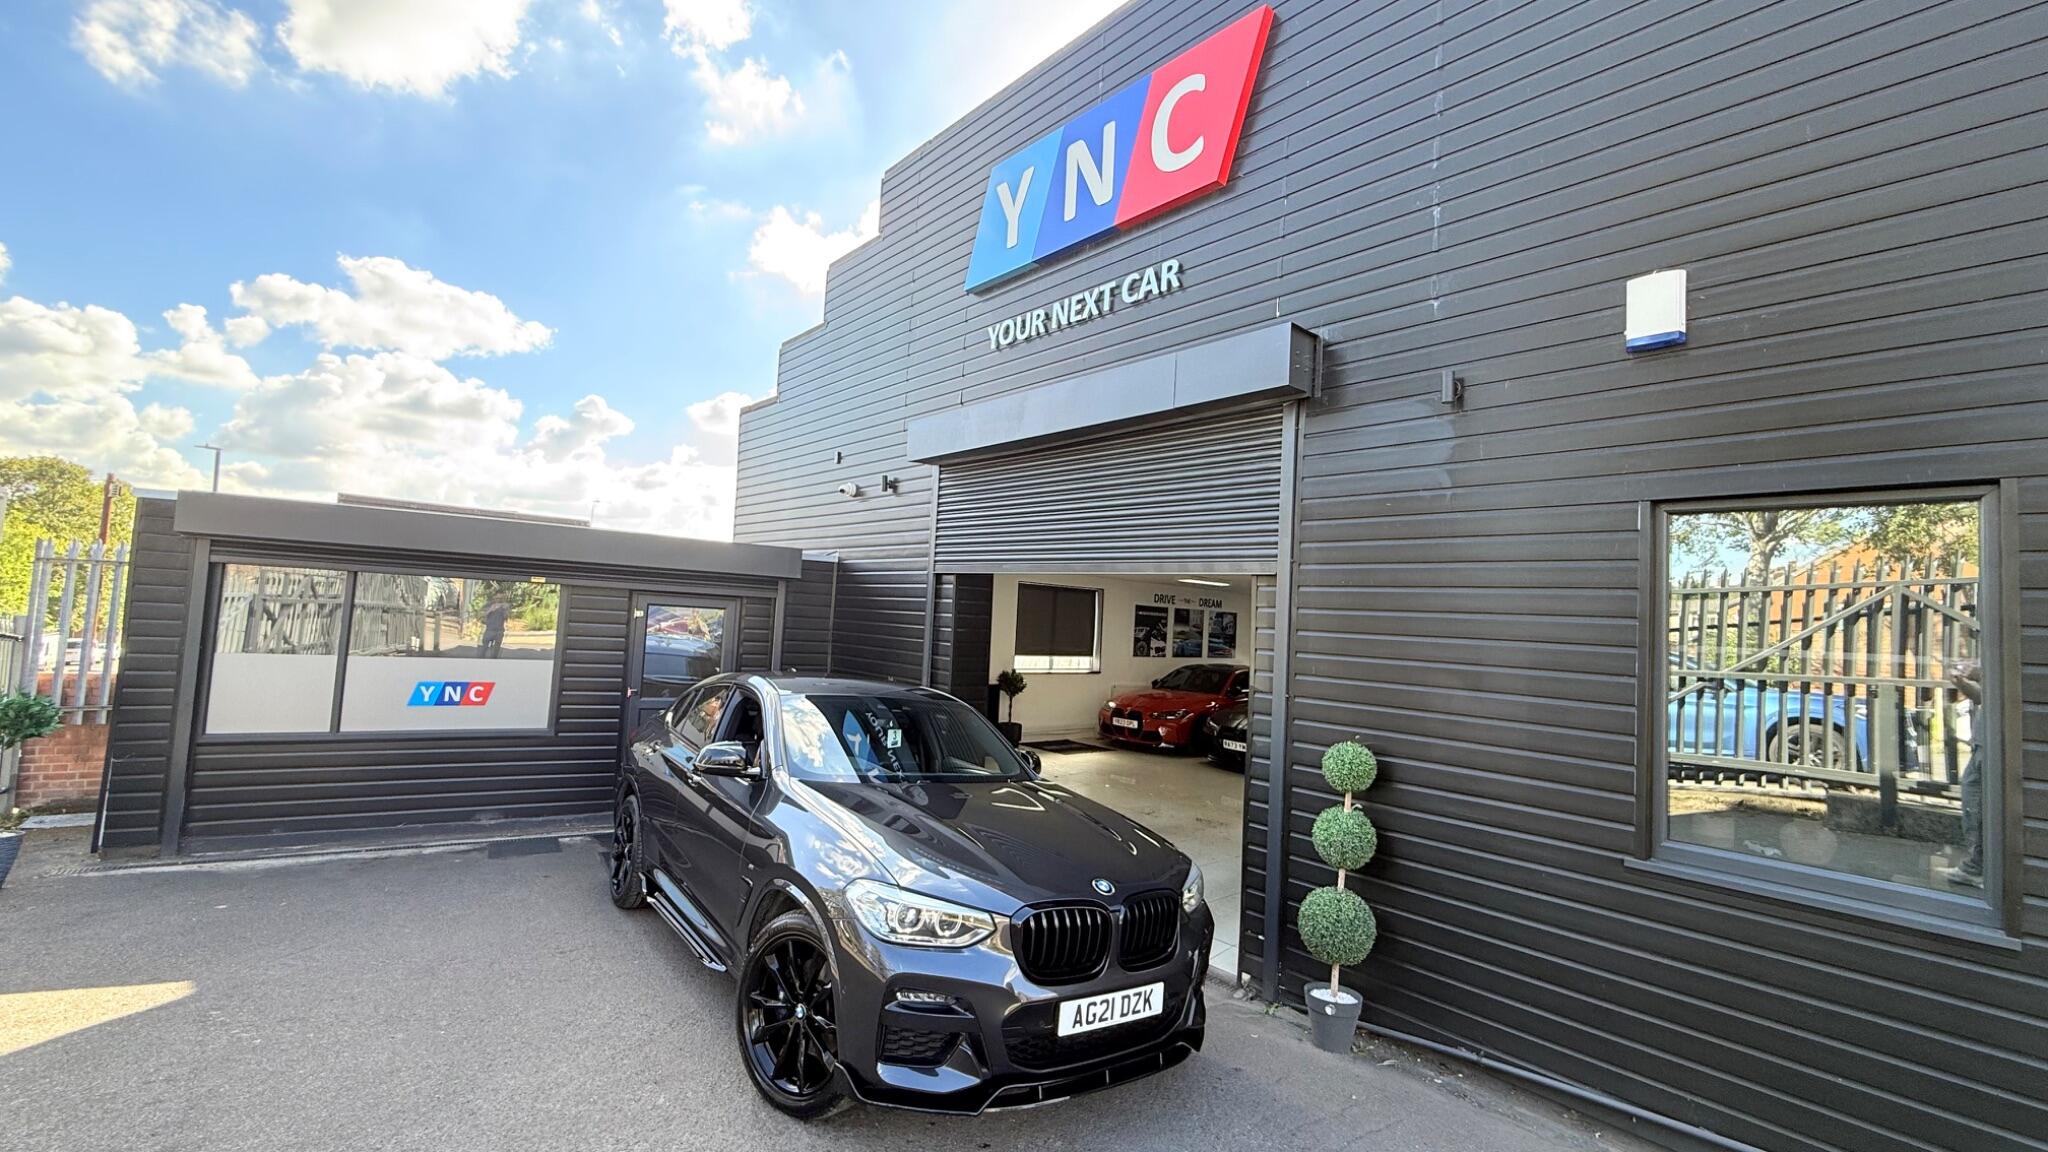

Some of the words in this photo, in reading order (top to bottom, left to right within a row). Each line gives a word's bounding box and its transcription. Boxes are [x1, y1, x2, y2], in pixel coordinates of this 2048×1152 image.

[996, 73, 1206, 249] YNC
[987, 308, 1047, 350] YOUR
[1051, 281, 1117, 330] NEXT
[1121, 258, 1181, 304] CAR
[1154, 593, 1176, 605] DRIVE
[1199, 597, 1222, 609] DREAM
[420, 685, 485, 702] YNC
[1072, 997, 1115, 1029] AG21
[1120, 988, 1154, 1018] DZK
